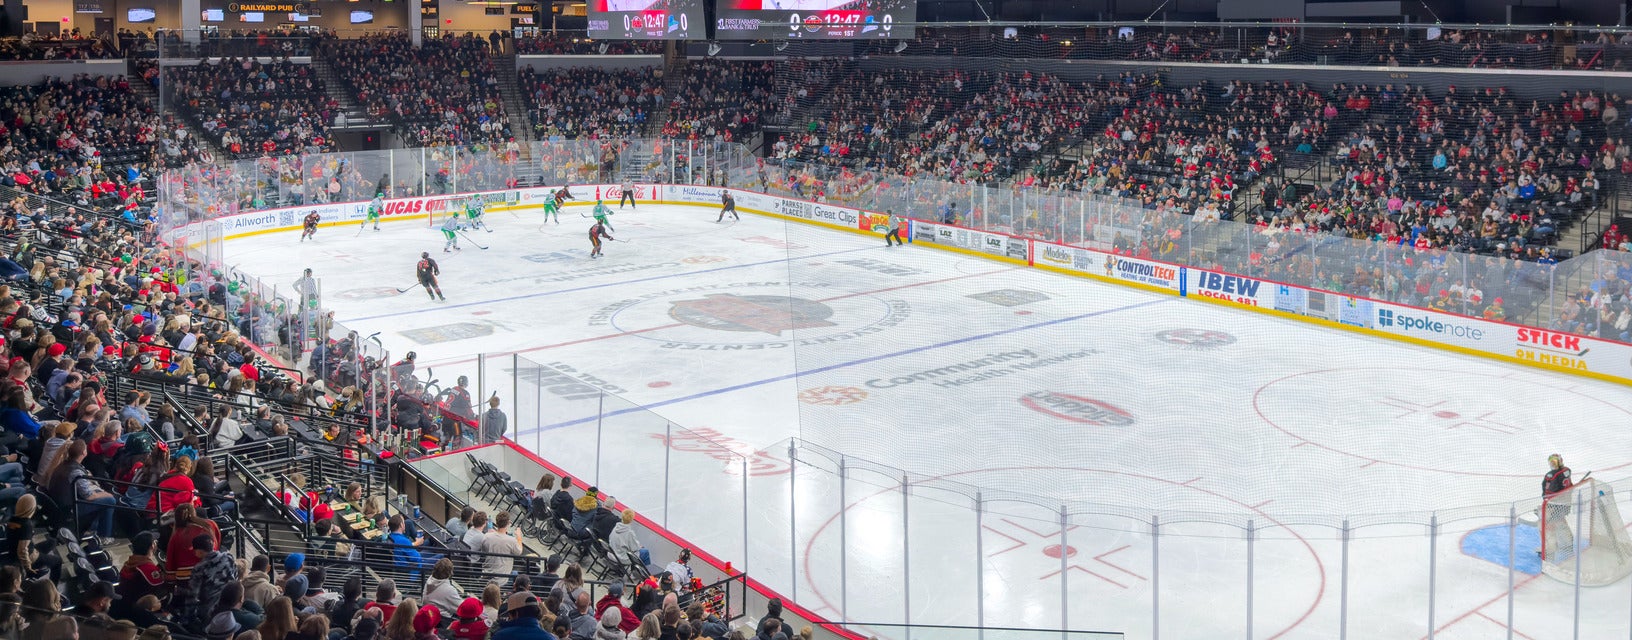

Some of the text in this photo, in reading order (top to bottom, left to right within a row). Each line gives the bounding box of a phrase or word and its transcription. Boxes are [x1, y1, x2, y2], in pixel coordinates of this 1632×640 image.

[623, 14, 630, 31] 0
[643, 14, 665, 28] 12:47
[680, 13, 688, 31] 0
[790, 13, 801, 31] 0
[824, 14, 861, 28] 12:47
[883, 14, 893, 31] 0
[782, 200, 799, 209] PARKS
[782, 207, 799, 216] PLACE
[235, 214, 276, 229] Allworth
[814, 206, 836, 220] Great
[838, 210, 857, 226] Clips
[940, 229, 952, 238] LAZ
[987, 238, 1001, 247] LAZ
[1046, 246, 1069, 261] Modelo
[1117, 259, 1175, 280] CONTROLTECH
[1121, 273, 1137, 281] HEATING
[1198, 271, 1260, 297] IBEW
[1198, 289, 1258, 306] LOCAL 481
[1397, 314, 1483, 340] spokenote
[659, 341, 789, 351] CENTER
[1517, 328, 1581, 351] STICK
[1515, 349, 1588, 370] ON MEDIA
[865, 347, 1038, 390] Community
[934, 348, 1105, 389] Health Network
